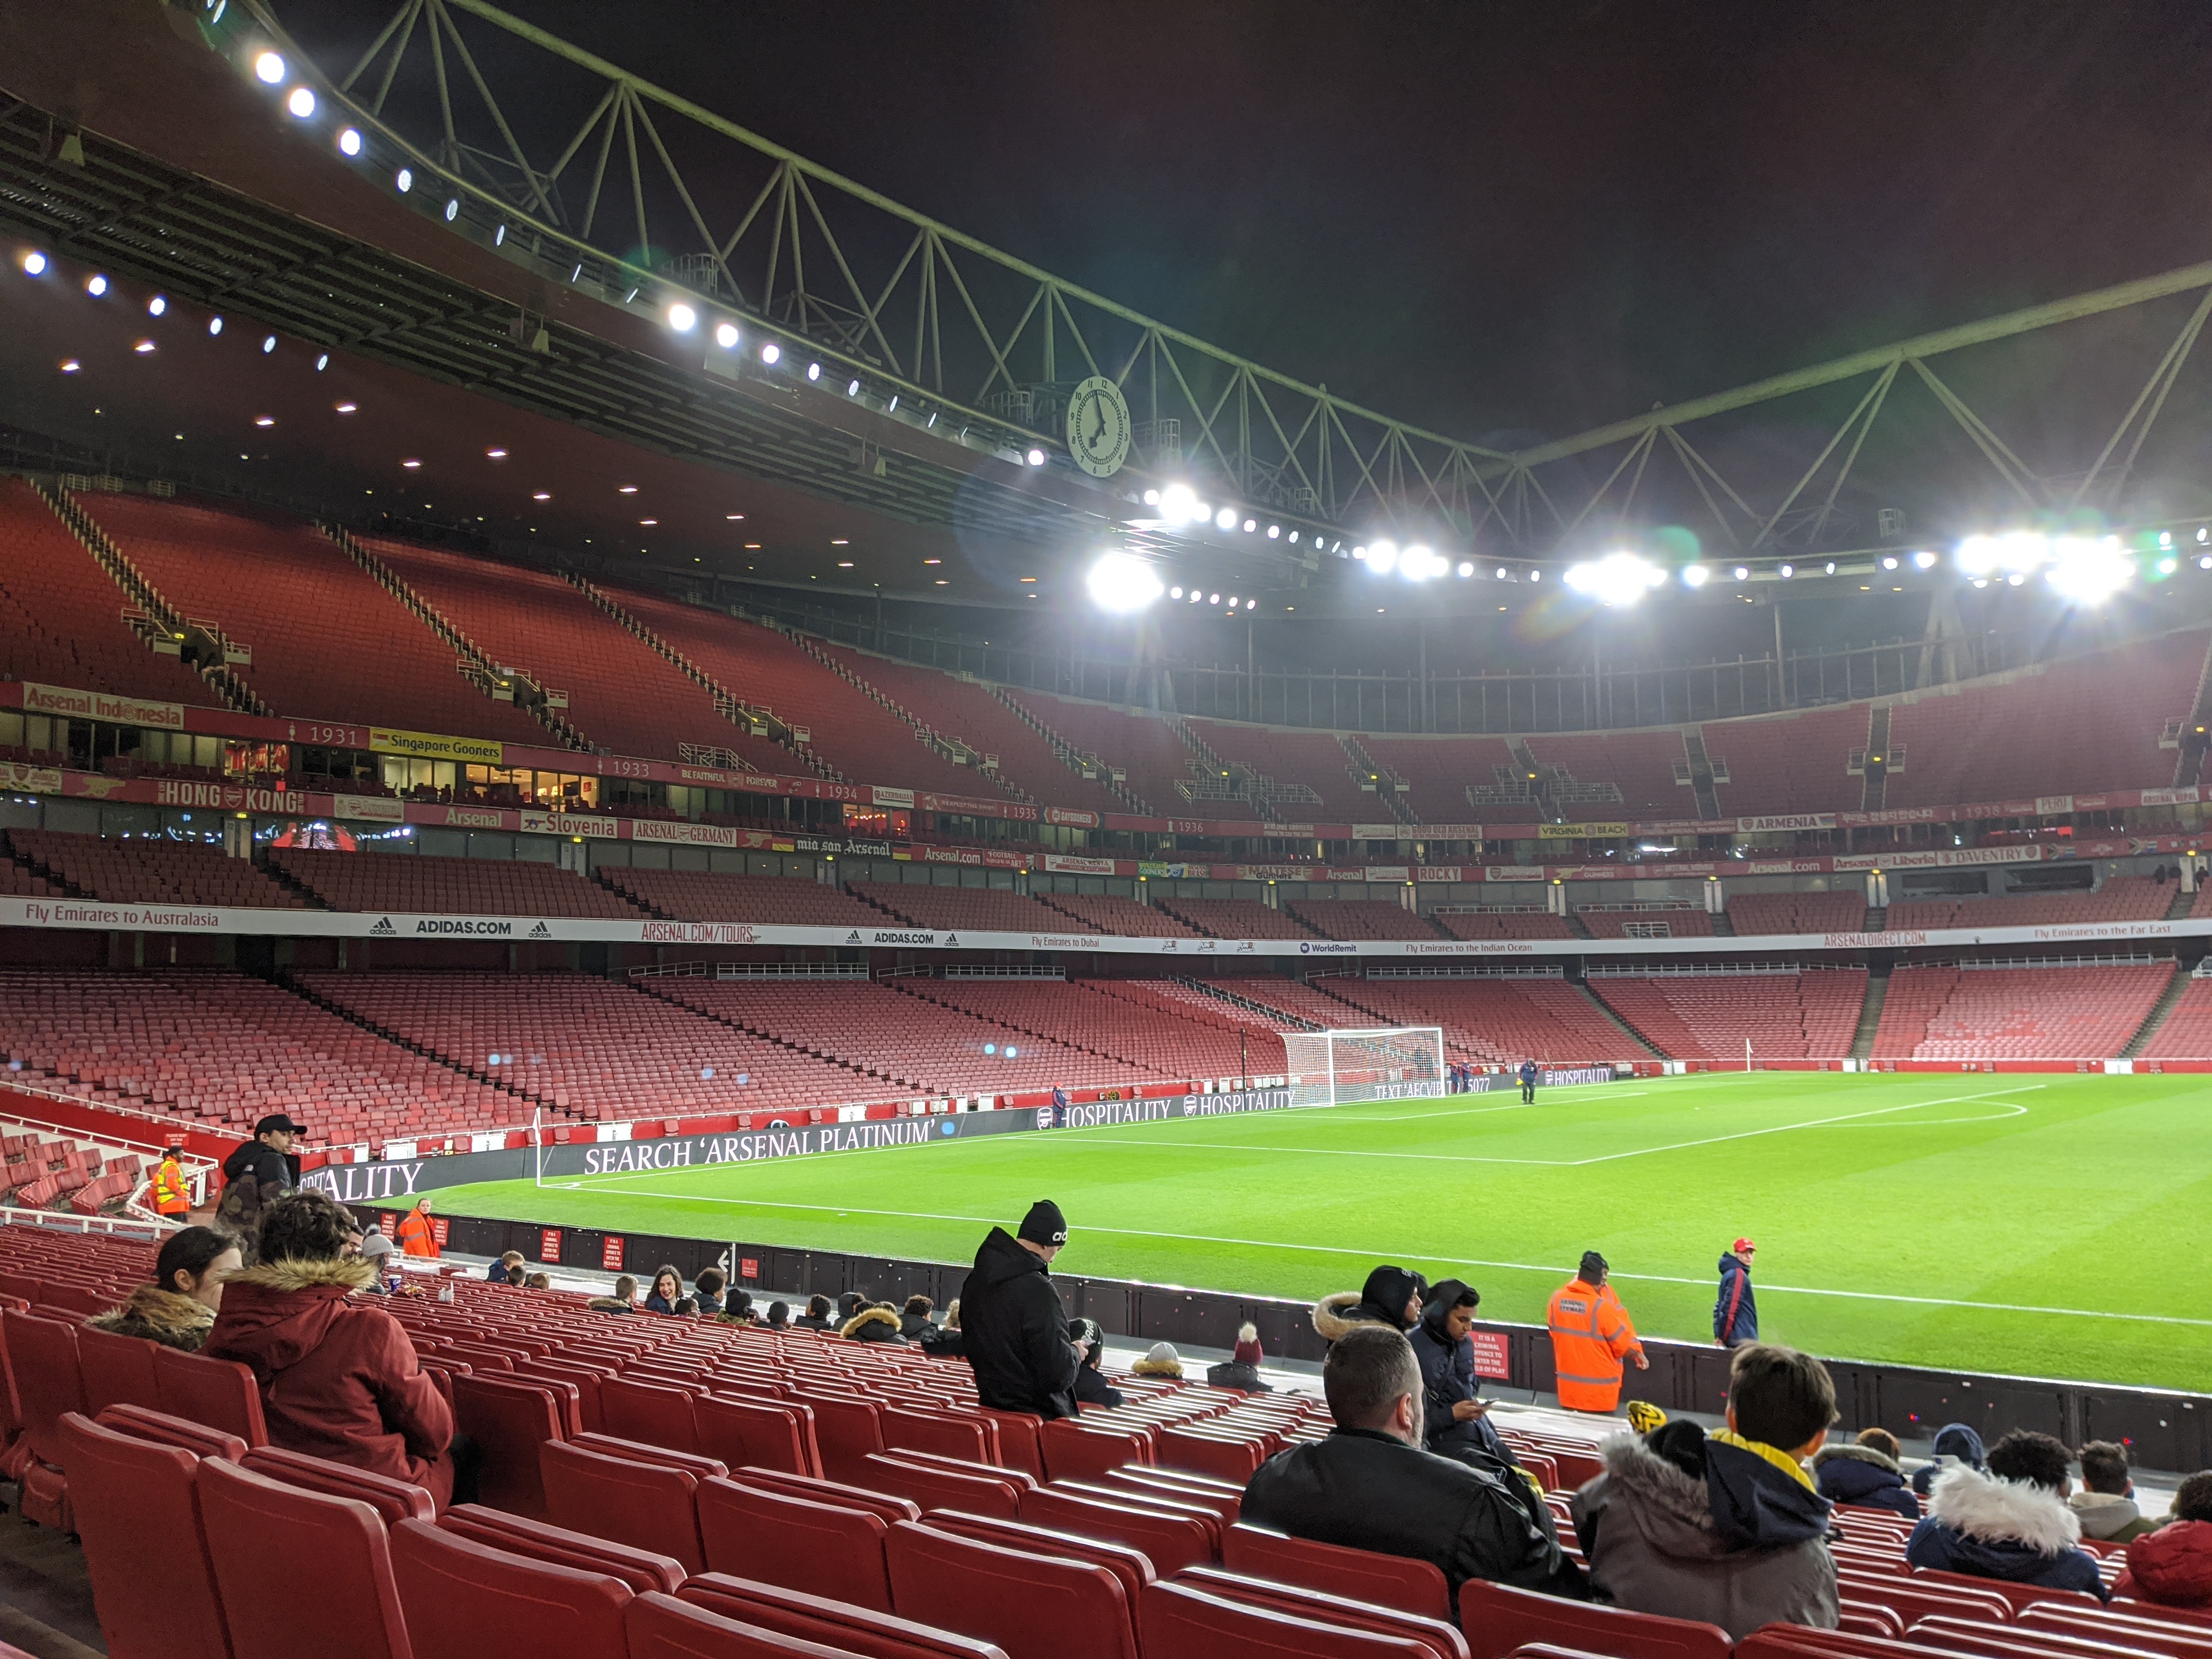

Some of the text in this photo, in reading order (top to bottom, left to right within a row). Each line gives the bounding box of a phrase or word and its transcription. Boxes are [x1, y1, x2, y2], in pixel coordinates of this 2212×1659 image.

[1088, 380, 1093, 388] 11
[1102, 379, 1107, 388] 12
[1075, 392, 1081, 400] 10
[1116, 391, 1119, 399] 1
[1070, 412, 1075, 420] 9
[1123, 410, 1127, 419] 2
[1071, 436, 1076, 444] 8
[1124, 433, 1128, 442] 3
[27, 687, 91, 714] Arsenal
[311, 726, 357, 746] 1931
[391, 734, 500, 758] Singapore Gooners
[613, 760, 650, 777] 1933
[682, 769, 778, 788] BE FAITHFUL FOREVER
[166, 781, 221, 807] HONG
[246, 788, 297, 813] KONG
[828, 785, 858, 800] 1934
[445, 808, 502, 827] Arsenal
[1014, 806, 1036, 820] 1935
[1967, 805, 2000, 818] 1938
[546, 814, 614, 836] Slovenia
[1180, 821, 1203, 833] 1936
[1542, 825, 1626, 835] VIRGINIA BEACH
[1756, 816, 1818, 830] ARMENIA
[635, 822, 734, 844] ARSENAL GERMANY
[844, 839, 891, 857] Arsenal
[924, 848, 980, 865] Arsenal.com
[1062, 857, 1086, 866] ARSENAL
[1835, 854, 1936, 870] Arsenal Liberia
[1955, 848, 2022, 864] DAVENTRY
[1248, 866, 1301, 876] MALTESE
[1748, 860, 1820, 873] Arsenal.com
[1326, 869, 1363, 881] Arsenal
[1418, 867, 1460, 881] ROCKY
[26, 904, 219, 927] Fly Emirates to Australasia
[416, 921, 511, 935] ADIDAS.COM
[641, 922, 753, 943] ARSENAL.COM/TOURS
[2034, 923, 2171, 940] Fly Emirates to the Far East
[874, 933, 934, 944] ADIDAS.COM
[1032, 936, 1099, 948] Fly Emirates to Dubai
[1824, 932, 1927, 948] ARSENALDIRECT.COM
[1312, 944, 1357, 953] WorldRemit
[1406, 944, 1418, 954] Fly
[1420, 944, 1454, 953] Emirates
[1466, 944, 1479, 952] the
[1481, 943, 1505, 952] Indian
[1508, 944, 1532, 952] Ocean
[1555, 1068, 1611, 1086] HOSPITALITY
[1464, 1077, 1490, 1093] 5077
[1200, 1090, 1296, 1114] HOSPITALITY
[1061, 1099, 1171, 1128] HOSPITALITY
[584, 1142, 692, 1175] SEARCH
[1561, 1299, 1585, 1307] ARSENAL
[1474, 1342, 1500, 1350] CRIMINAL
